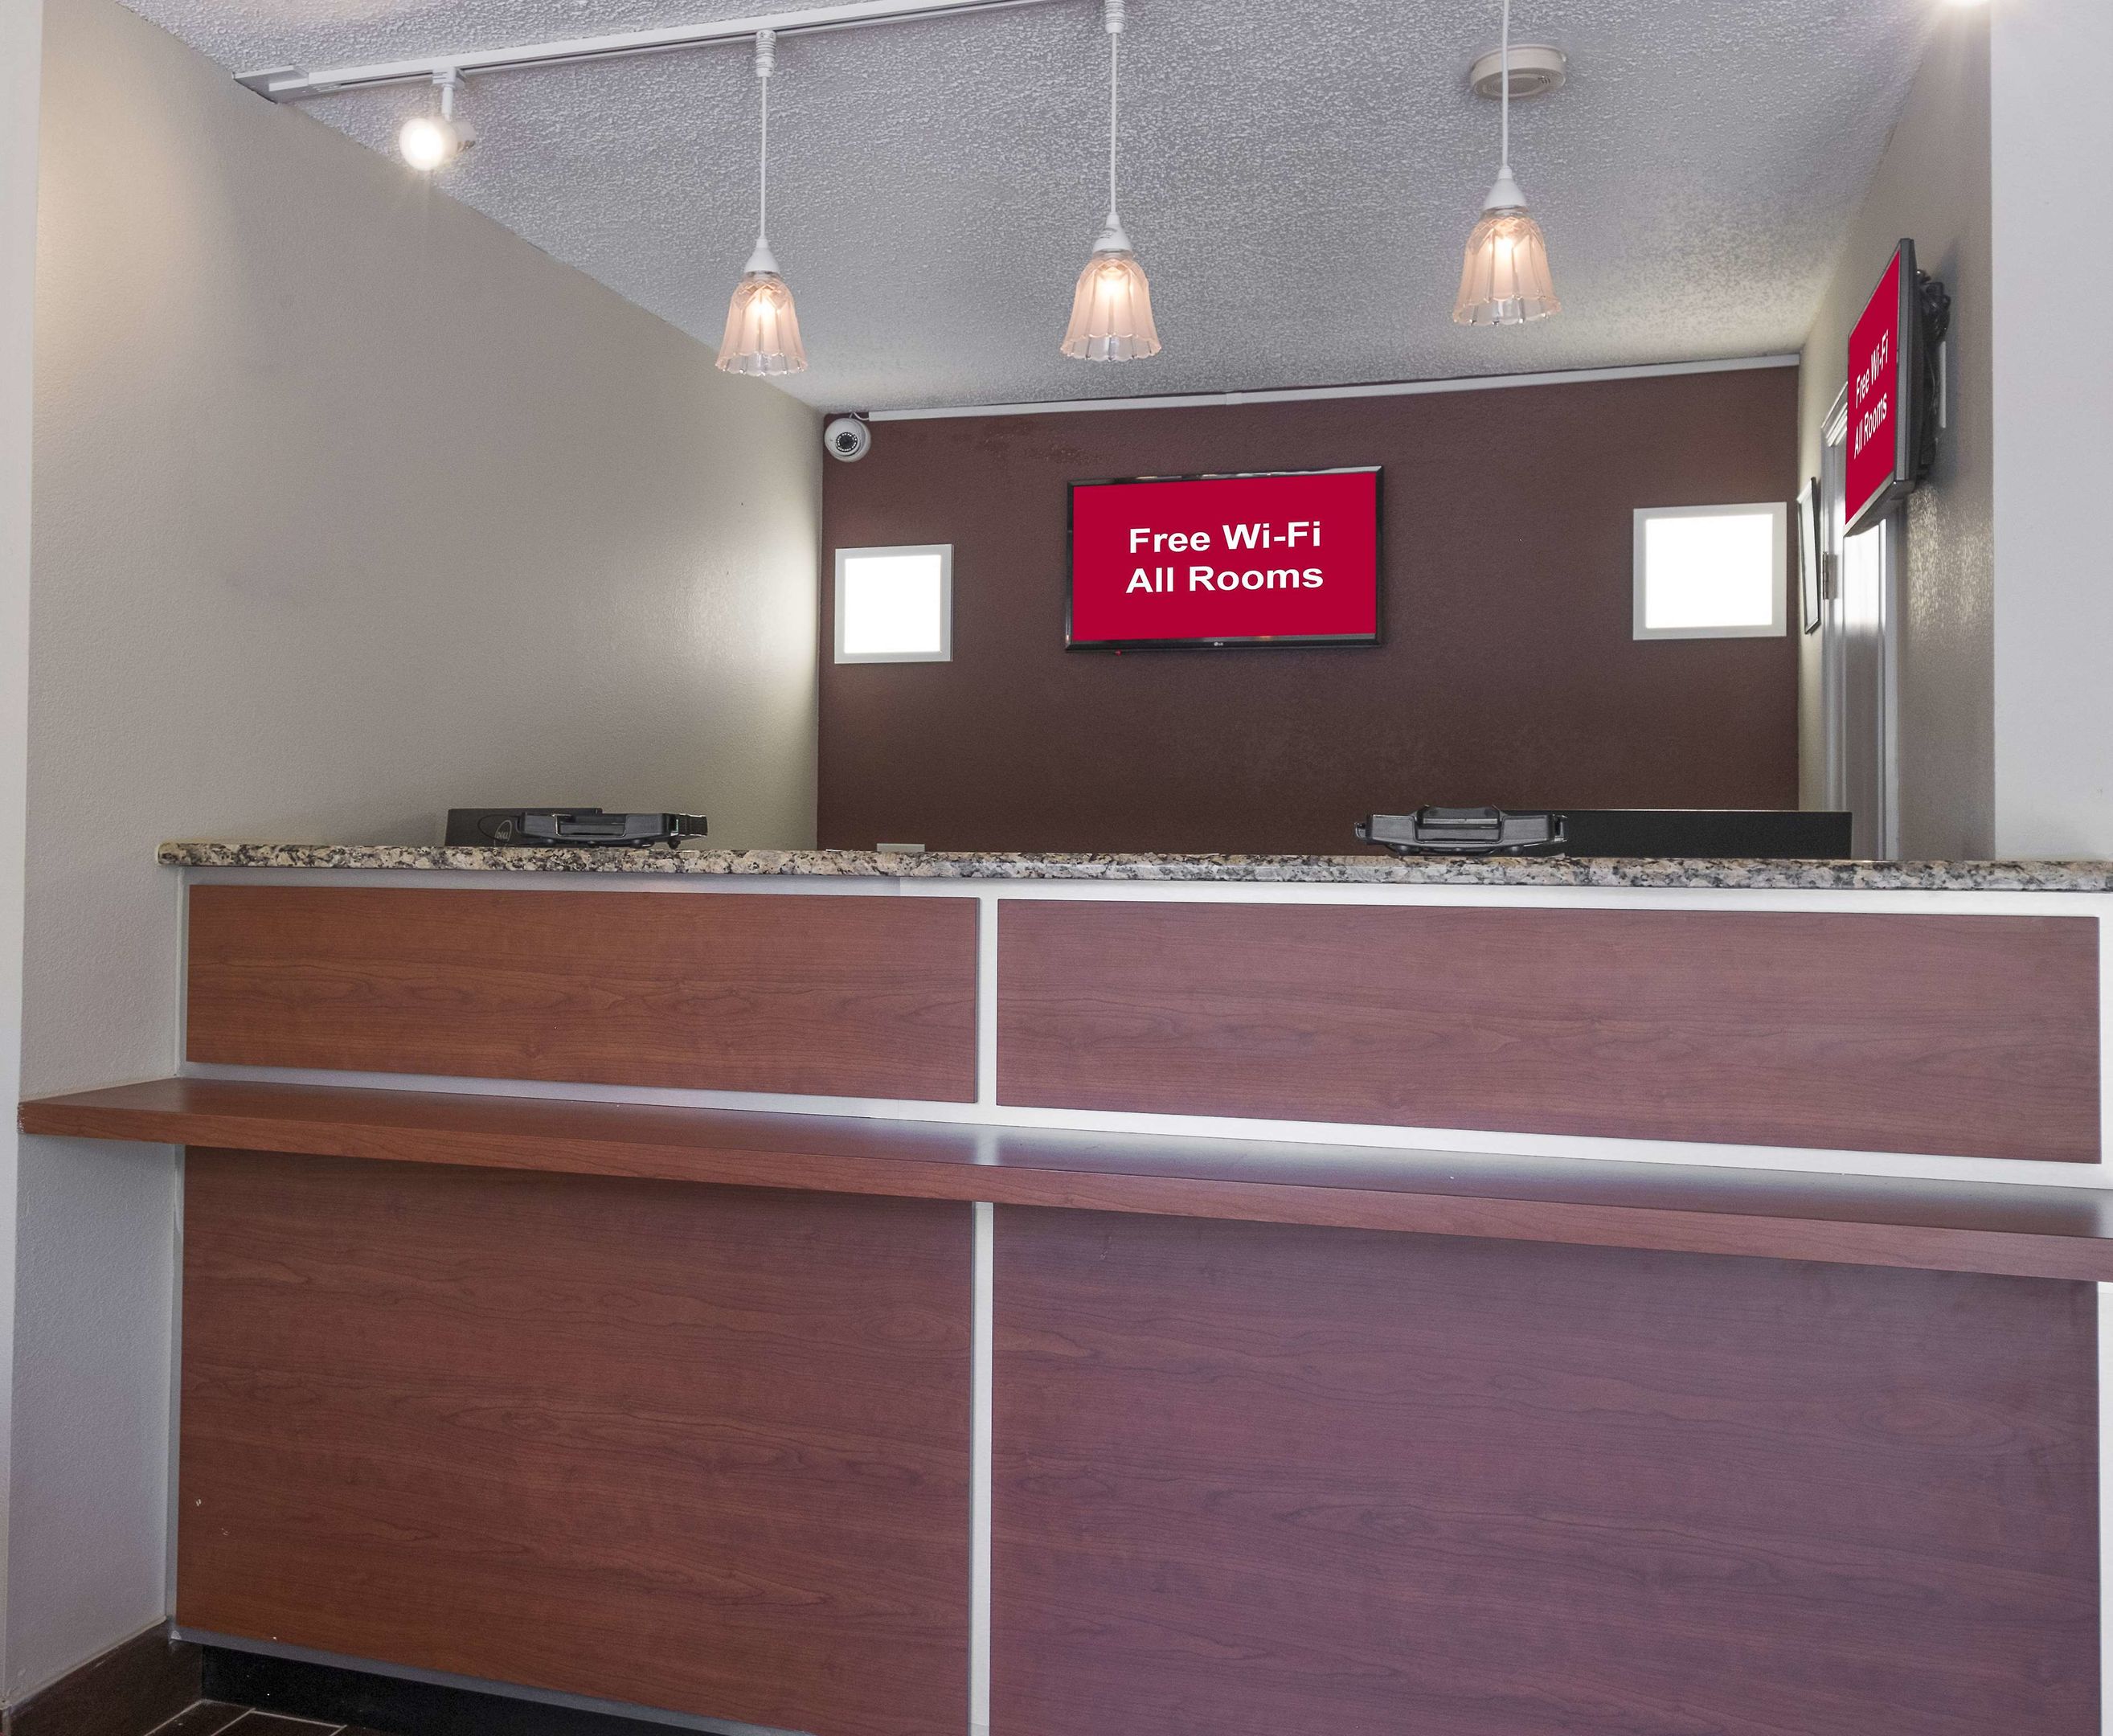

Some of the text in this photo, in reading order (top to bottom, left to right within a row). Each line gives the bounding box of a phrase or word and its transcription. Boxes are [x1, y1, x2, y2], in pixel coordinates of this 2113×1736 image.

[1855, 330, 1889, 408] Free Wi-Fi
[1853, 392, 1887, 459] All Rooms
[1129, 521, 1321, 554] Free Wi-Fi
[1125, 566, 1324, 594] All Rooms
